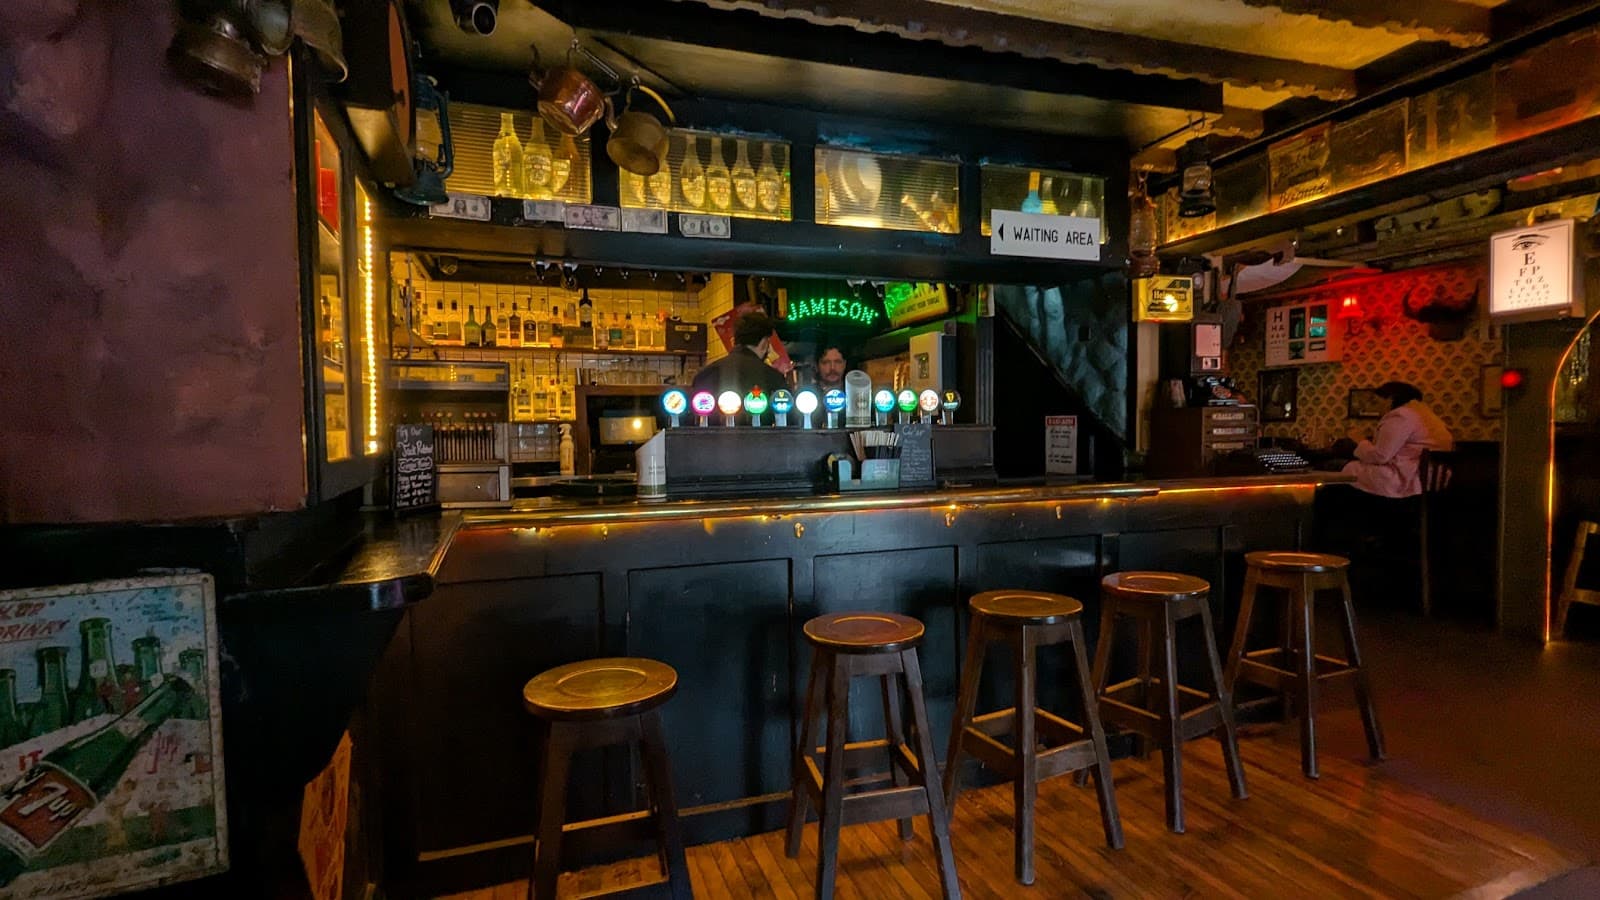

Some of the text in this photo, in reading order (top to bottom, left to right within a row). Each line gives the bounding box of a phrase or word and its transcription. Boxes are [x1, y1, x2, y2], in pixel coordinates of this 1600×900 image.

[1013, 225, 1094, 246] WAITING AREA
[1524, 251, 1536, 266] E
[787, 298, 874, 325] JAMESON
[1273, 311, 1284, 323] H
